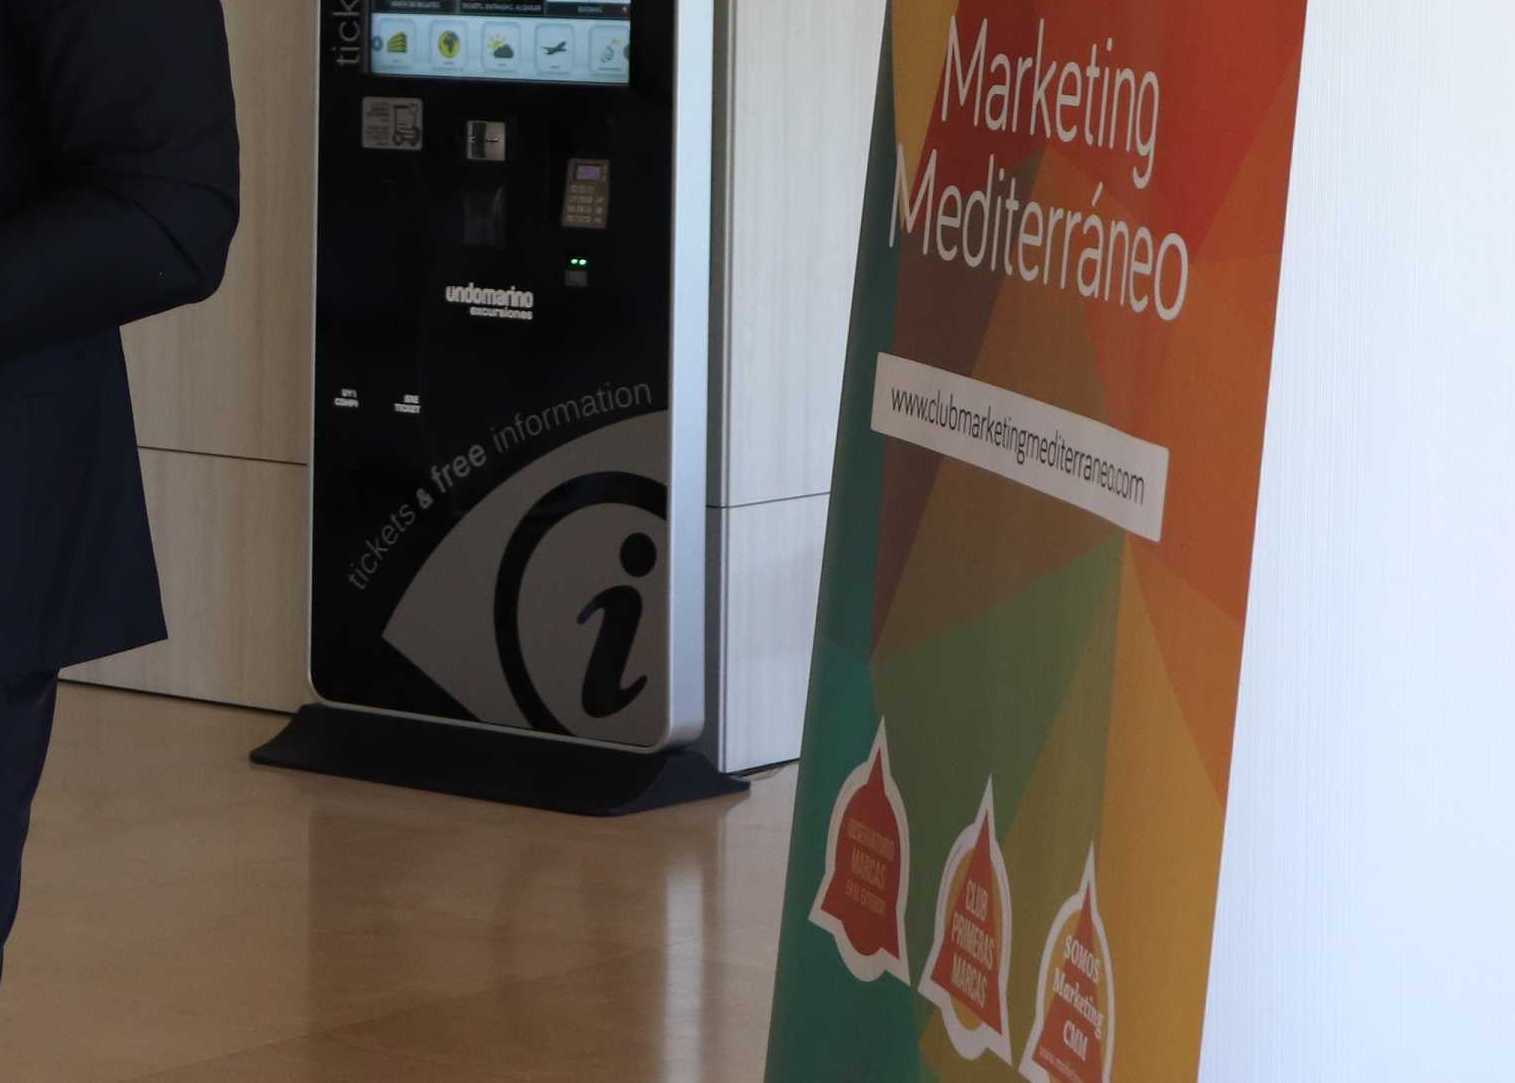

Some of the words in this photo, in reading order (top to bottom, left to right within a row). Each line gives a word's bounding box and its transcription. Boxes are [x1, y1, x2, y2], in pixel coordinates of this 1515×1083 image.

[941, 15, 1160, 190] Marketing
[888, 141, 1189, 321] Mediterráneo
[469, 306, 534, 320] excursiones
[890, 386, 1146, 506] www.clubmarketingmediterraneo.com
[348, 501, 416, 590] tickets
[416, 487, 433, 510] &
[430, 443, 487, 493] free
[490, 381, 653, 454] information
[965, 879, 989, 922] CLUB
[950, 911, 996, 971] PRIMERAS
[1063, 933, 1100, 983] SOMOS
[950, 950, 987, 1009] MARCAS
[1052, 966, 1105, 1039] Marketing
